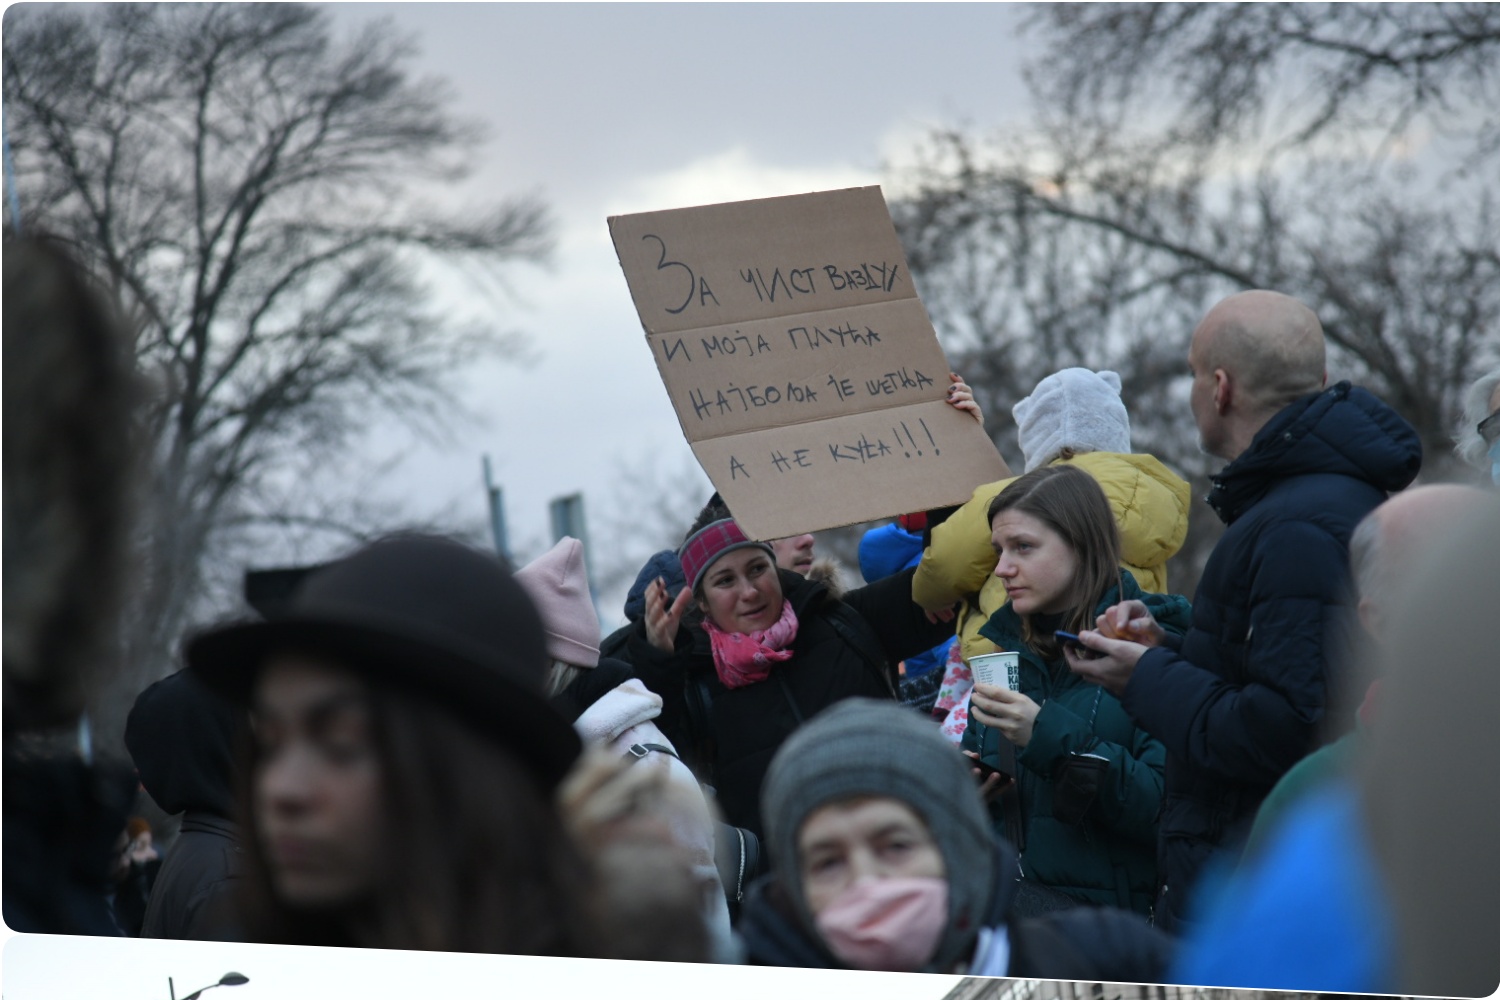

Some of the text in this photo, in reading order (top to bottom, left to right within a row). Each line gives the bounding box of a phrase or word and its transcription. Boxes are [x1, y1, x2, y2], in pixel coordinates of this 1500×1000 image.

[740, 267, 817, 303] ЧИСТ
[823, 261, 902, 292] ВАЗДУХ
[662, 322, 881, 362] И МОЈА ПЛУЋА
[688, 367, 933, 420] НАЈБОЉА ЈЕ ШЕТЊА
[729, 455, 750, 480] А
[771, 449, 812, 473] НЕ
